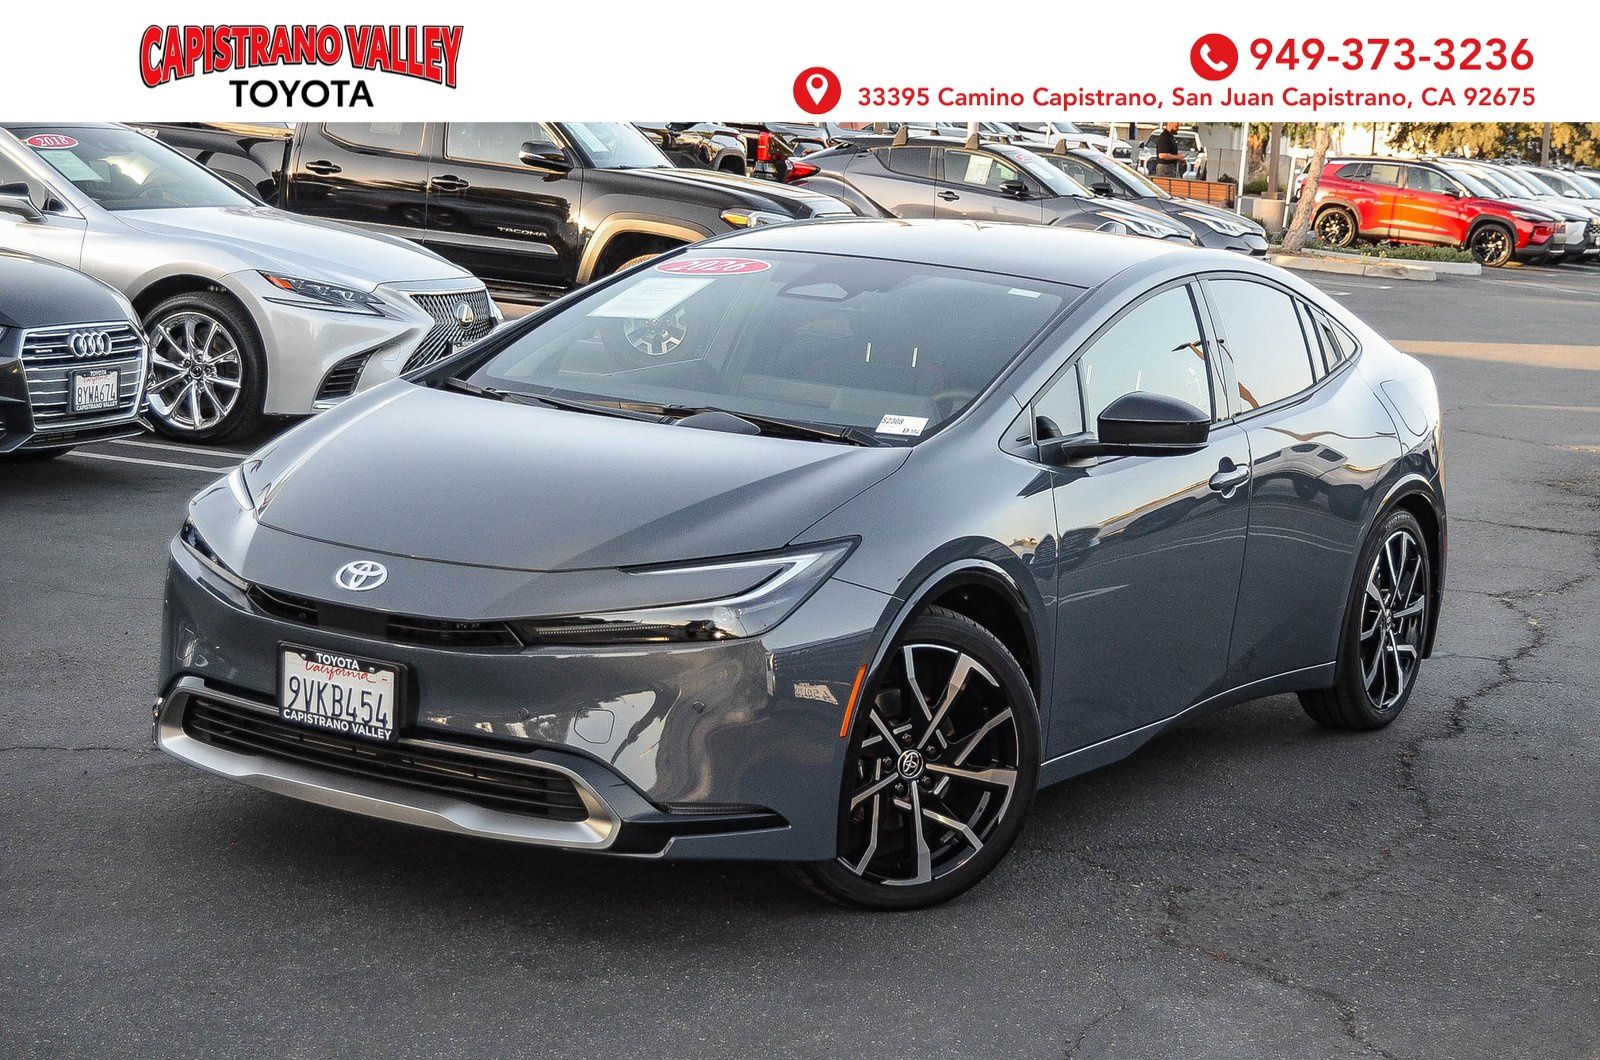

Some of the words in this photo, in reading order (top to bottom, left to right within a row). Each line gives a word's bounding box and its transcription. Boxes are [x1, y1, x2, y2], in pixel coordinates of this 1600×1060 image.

[36, 135, 69, 147] 2018
[496, 226, 548, 238] TACOMA
[672, 259, 753, 272] 2026
[315, 652, 360, 671] TOYOTA
[287, 676, 389, 728] 9VKB454
[283, 708, 349, 731] CAPISTRANO
[352, 722, 392, 741] VALLEY
